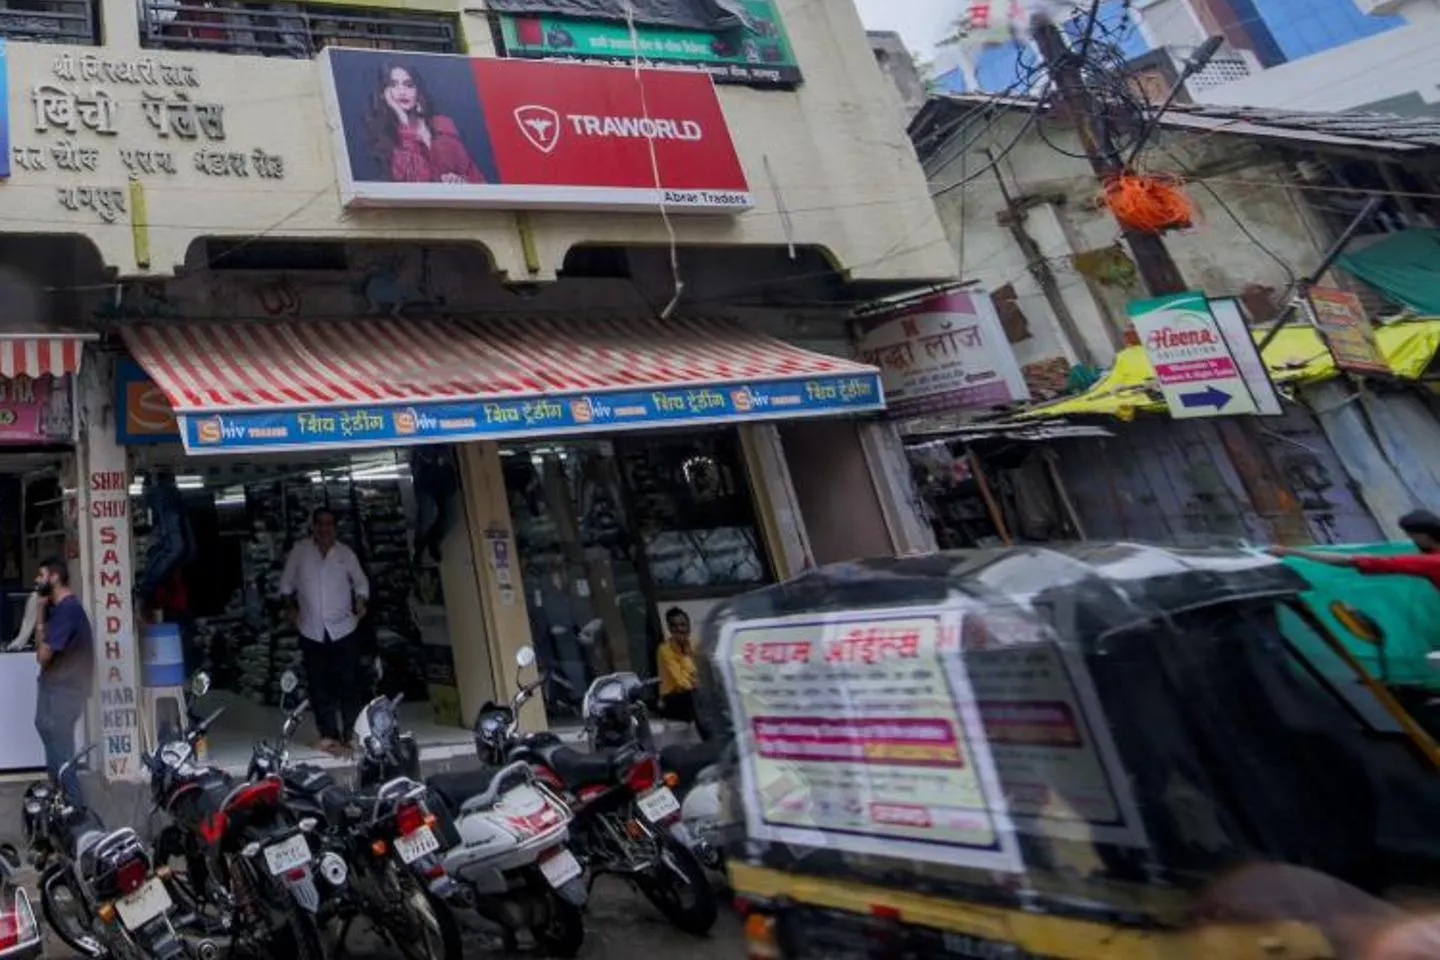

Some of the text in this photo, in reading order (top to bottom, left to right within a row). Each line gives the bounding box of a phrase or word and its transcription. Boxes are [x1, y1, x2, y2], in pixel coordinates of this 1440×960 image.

[567, 112, 704, 143] TRAWORLD
[664, 190, 748, 206] Abrar Traders
[91, 471, 126, 492] SHRI
[91, 499, 127, 518] SHIV
